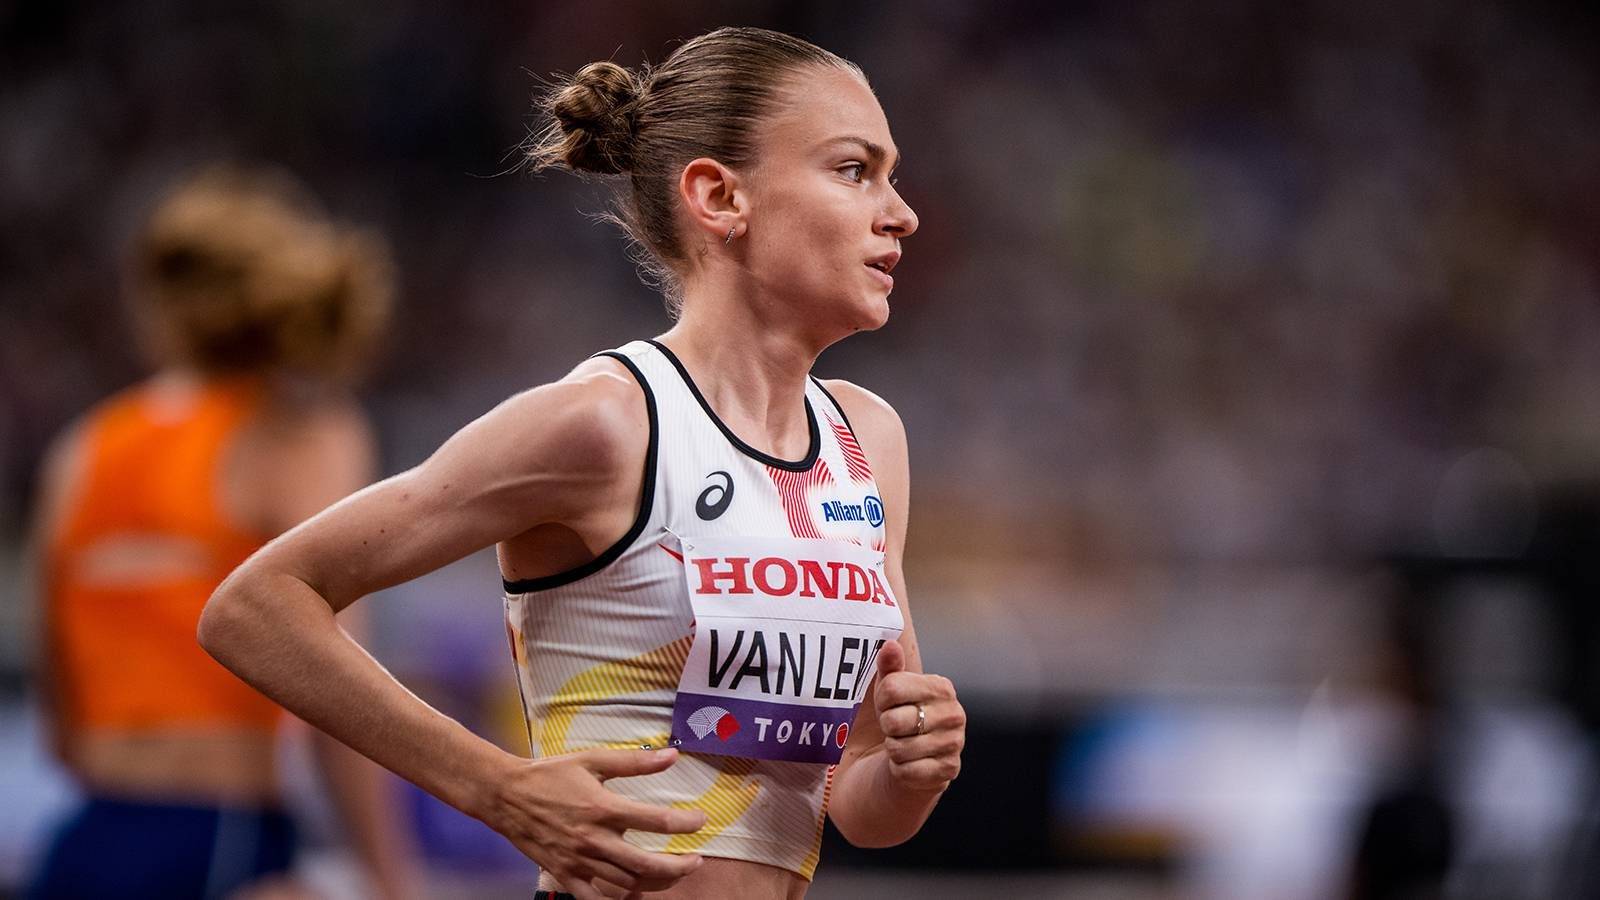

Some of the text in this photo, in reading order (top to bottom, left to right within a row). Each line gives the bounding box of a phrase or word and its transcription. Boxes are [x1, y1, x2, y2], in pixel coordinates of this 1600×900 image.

[822, 501, 865, 522] Allianz
[691, 557, 895, 606] HONDA
[708, 629, 806, 697] VAN
[754, 717, 849, 749] TOKYO
